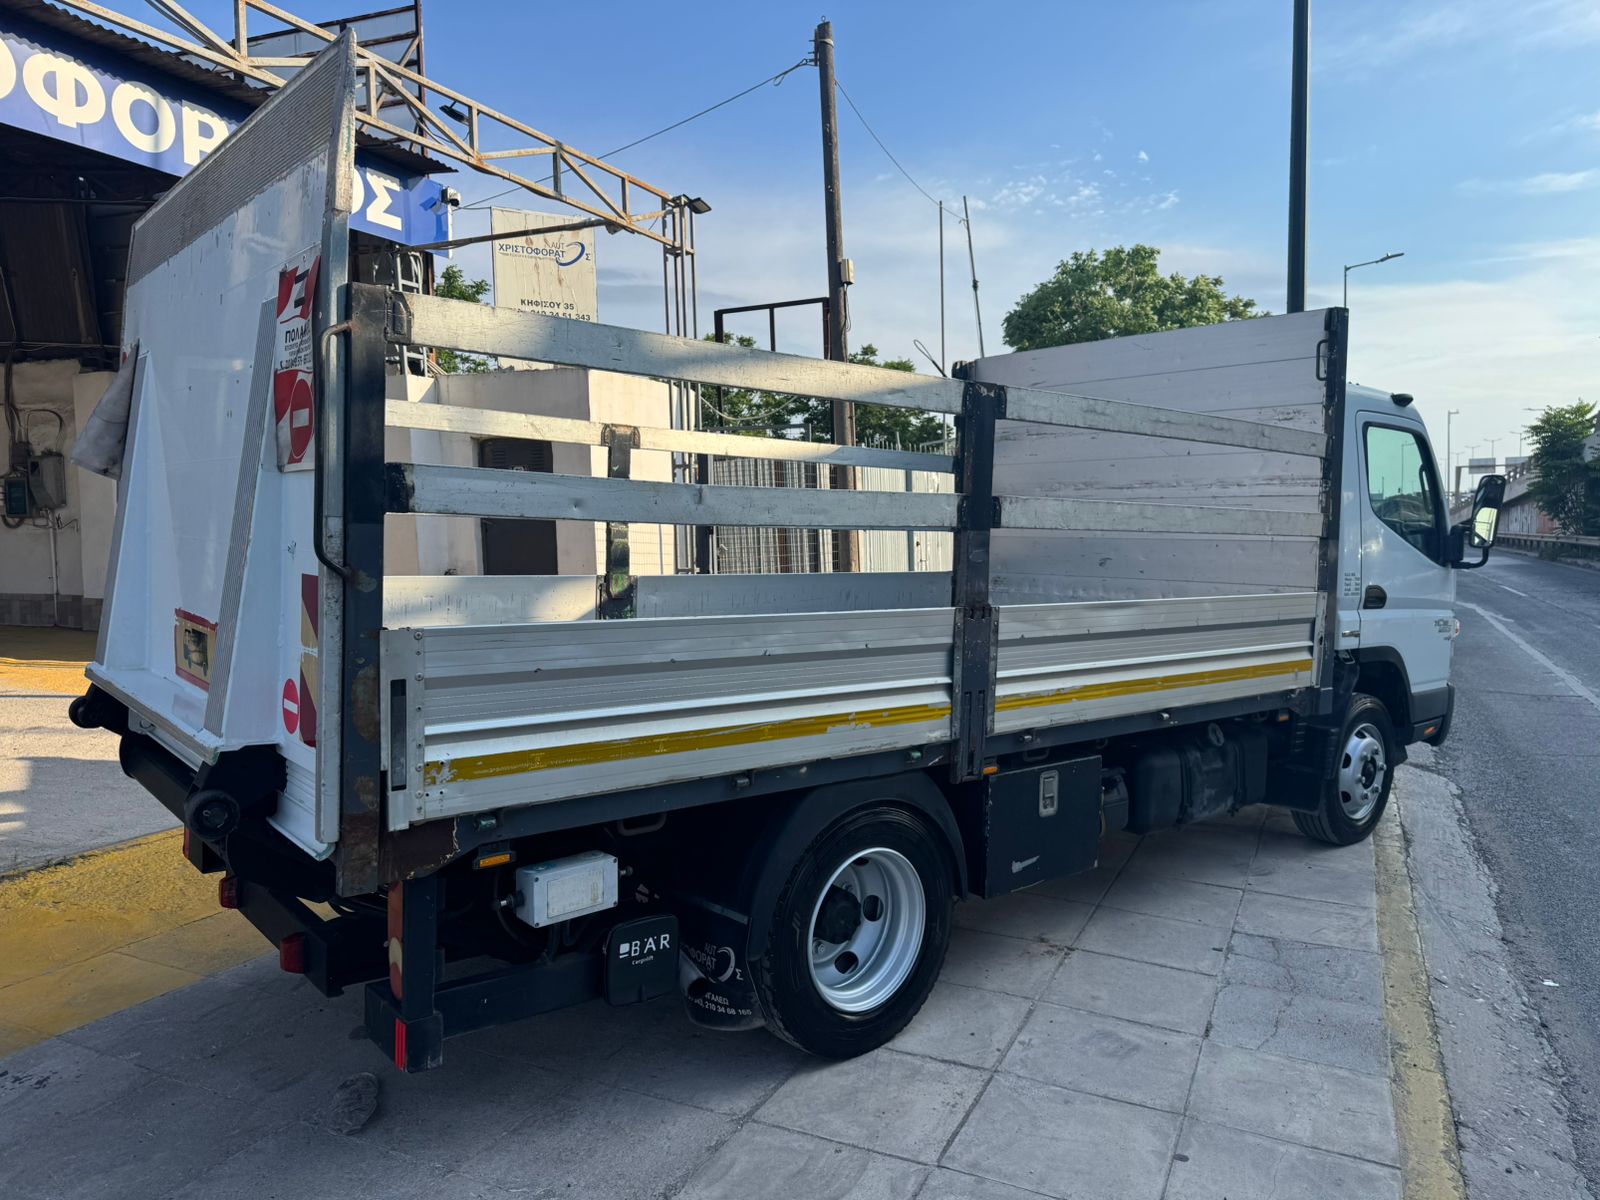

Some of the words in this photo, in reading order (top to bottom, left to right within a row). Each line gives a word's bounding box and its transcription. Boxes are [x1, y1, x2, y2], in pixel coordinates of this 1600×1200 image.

[520, 299, 561, 309] ΚΗΦΙΣΟΥ
[575, 313, 591, 321] 343
[631, 933, 670, 957] BÄR
